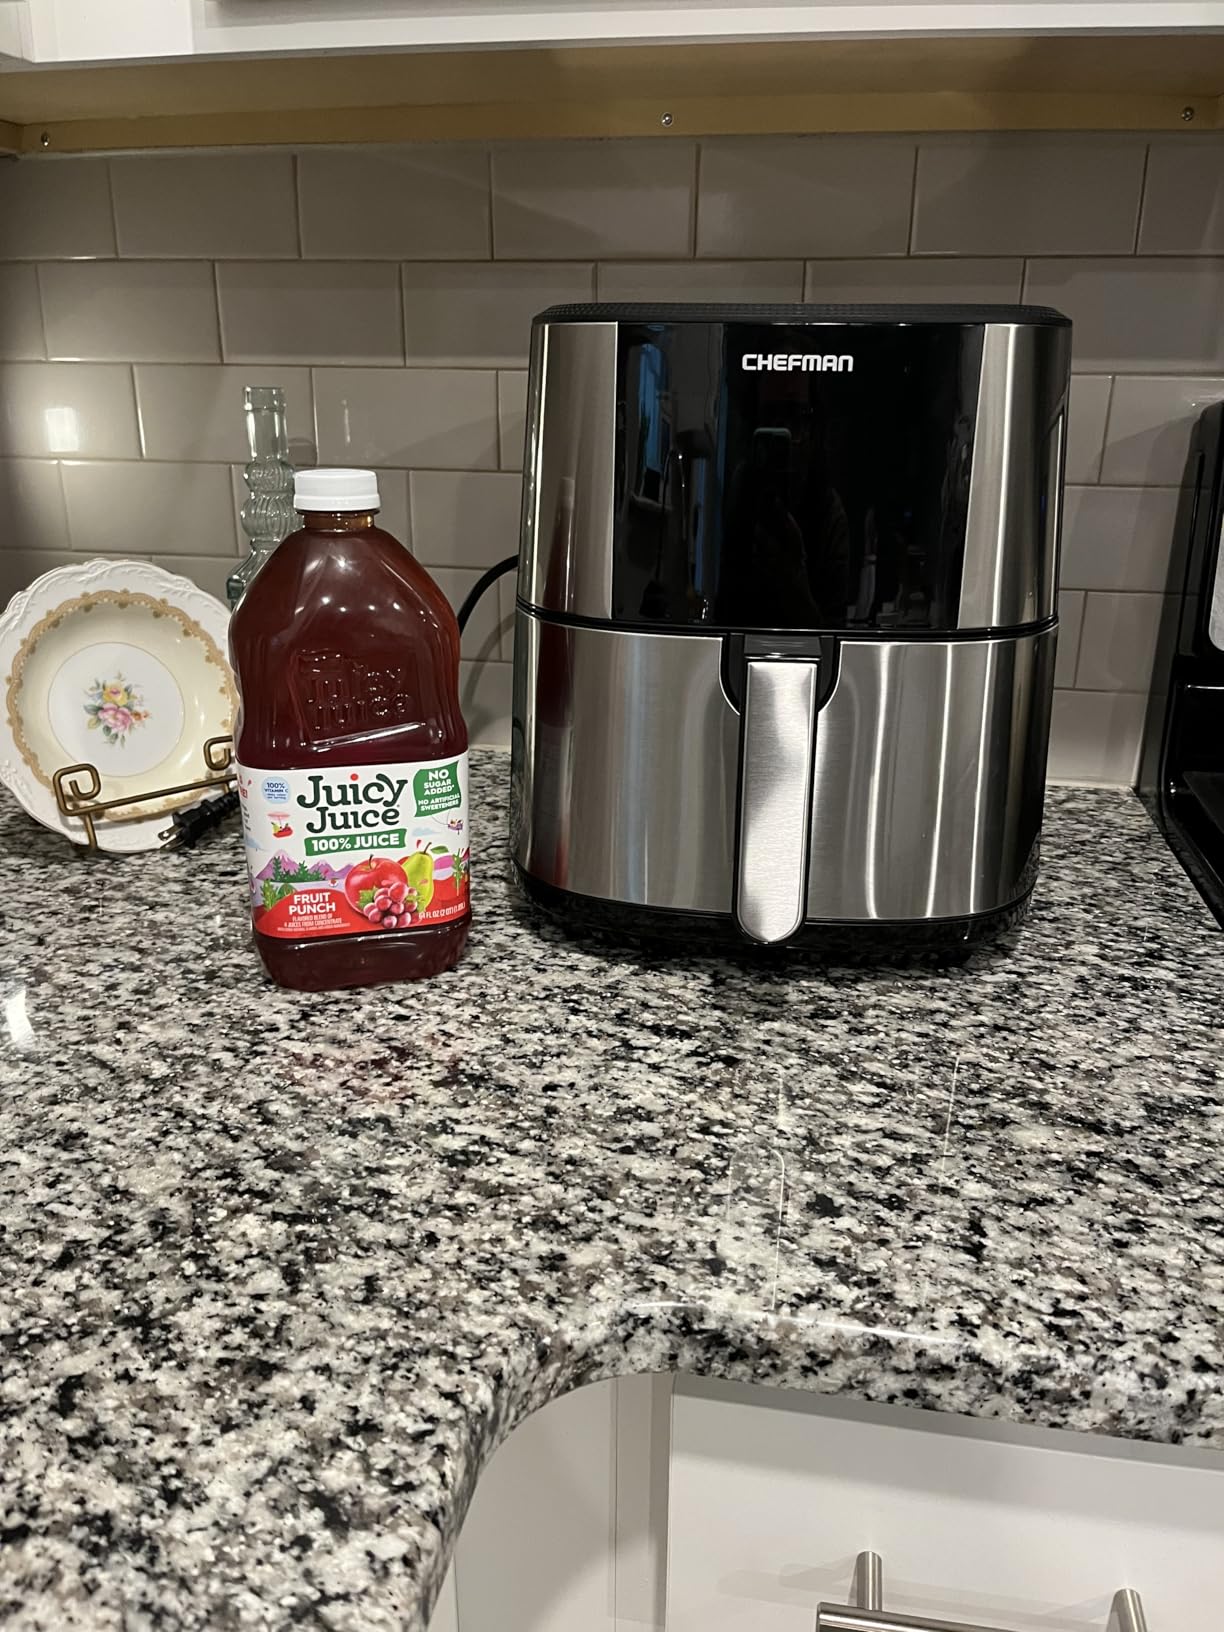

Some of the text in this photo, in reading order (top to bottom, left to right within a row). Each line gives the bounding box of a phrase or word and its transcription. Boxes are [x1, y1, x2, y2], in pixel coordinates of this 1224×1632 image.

[742, 354, 854, 372] CHEFMAN
[428, 769, 449, 781] NO
[297, 773, 408, 808] Juicy
[424, 778, 452, 789] SUGAR
[306, 807, 400, 834] Juice
[312, 833, 400, 852] 100% JUICE
[294, 892, 331, 905] FRUIT
[288, 902, 336, 916] PUNCH
